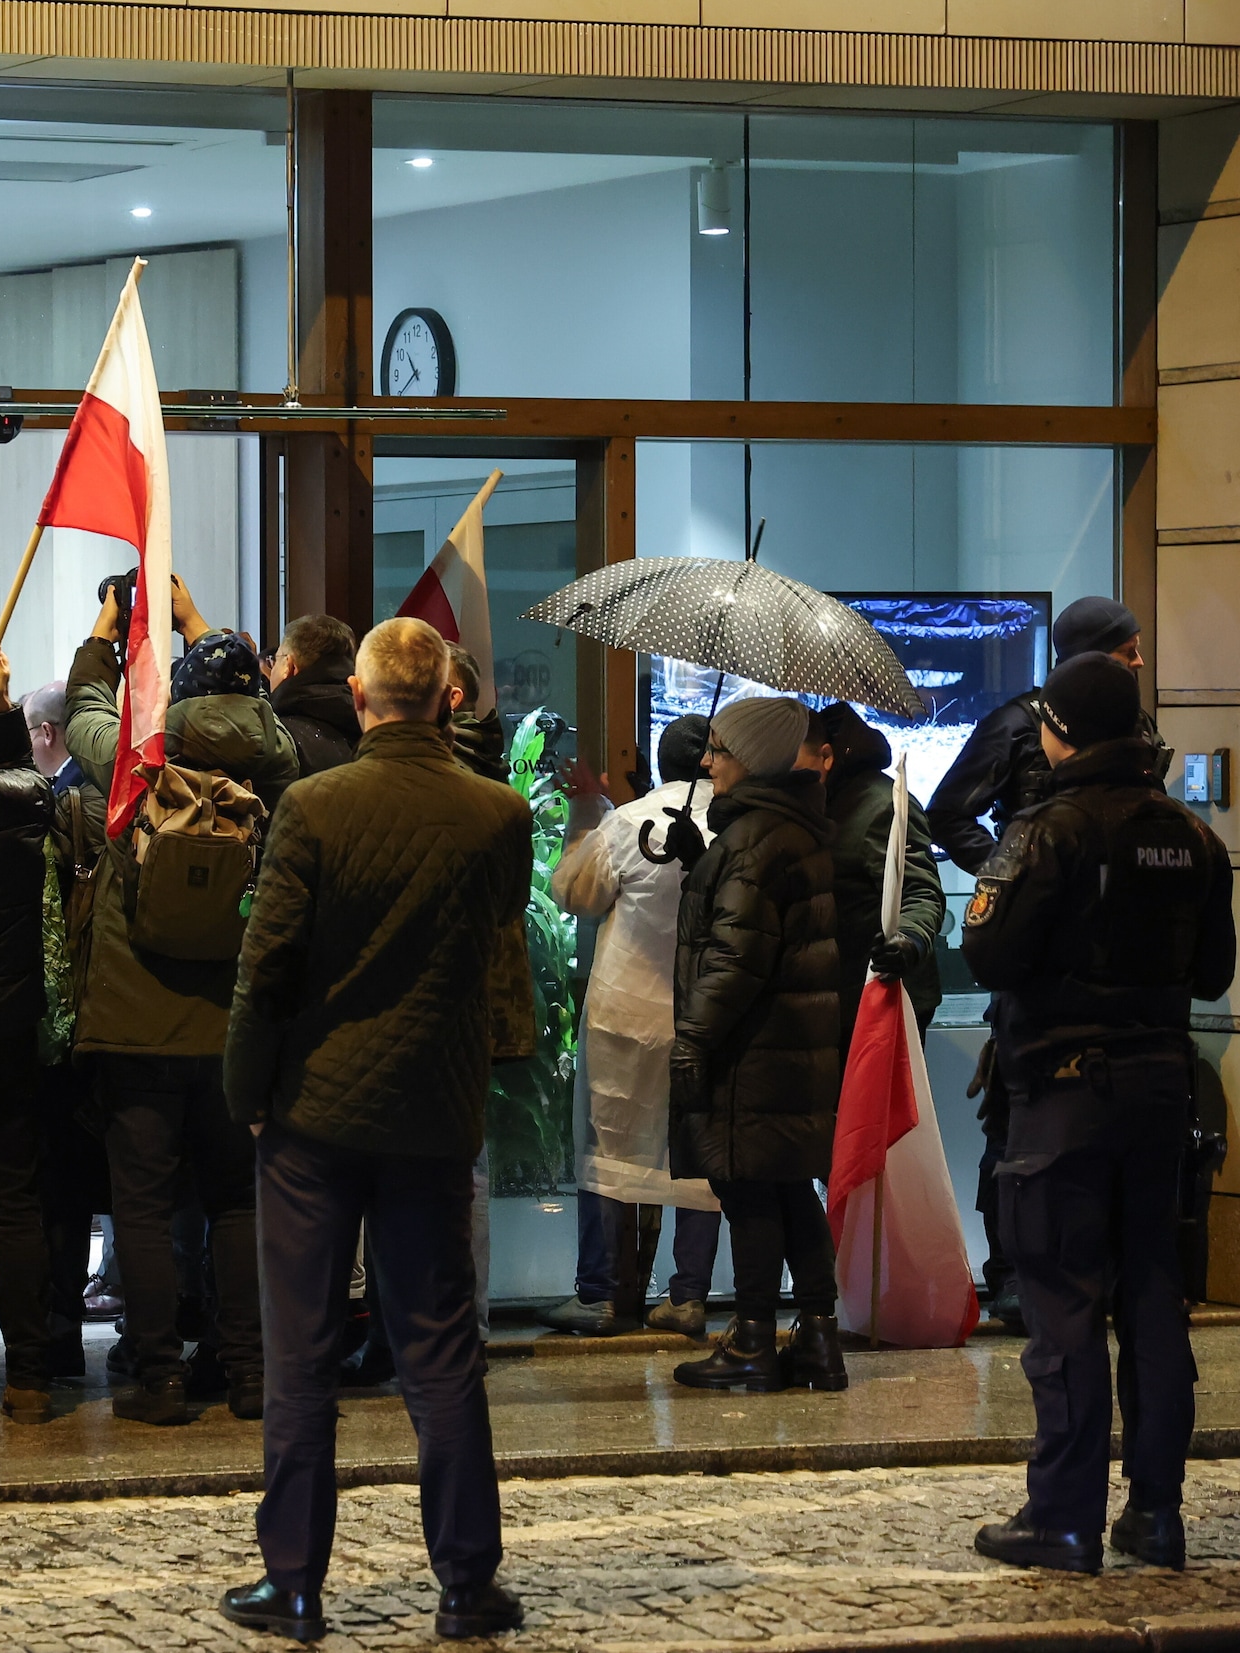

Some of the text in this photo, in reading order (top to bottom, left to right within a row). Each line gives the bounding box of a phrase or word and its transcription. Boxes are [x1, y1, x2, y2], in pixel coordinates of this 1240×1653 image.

[403, 331, 411, 344] 11
[413, 324, 421, 338] 12
[396, 348, 405, 361] 10
[431, 346, 436, 359] 2
[394, 369, 399, 382] 9
[1043, 701, 1069, 735] POLICJA
[1137, 847, 1193, 867] POLICJA
